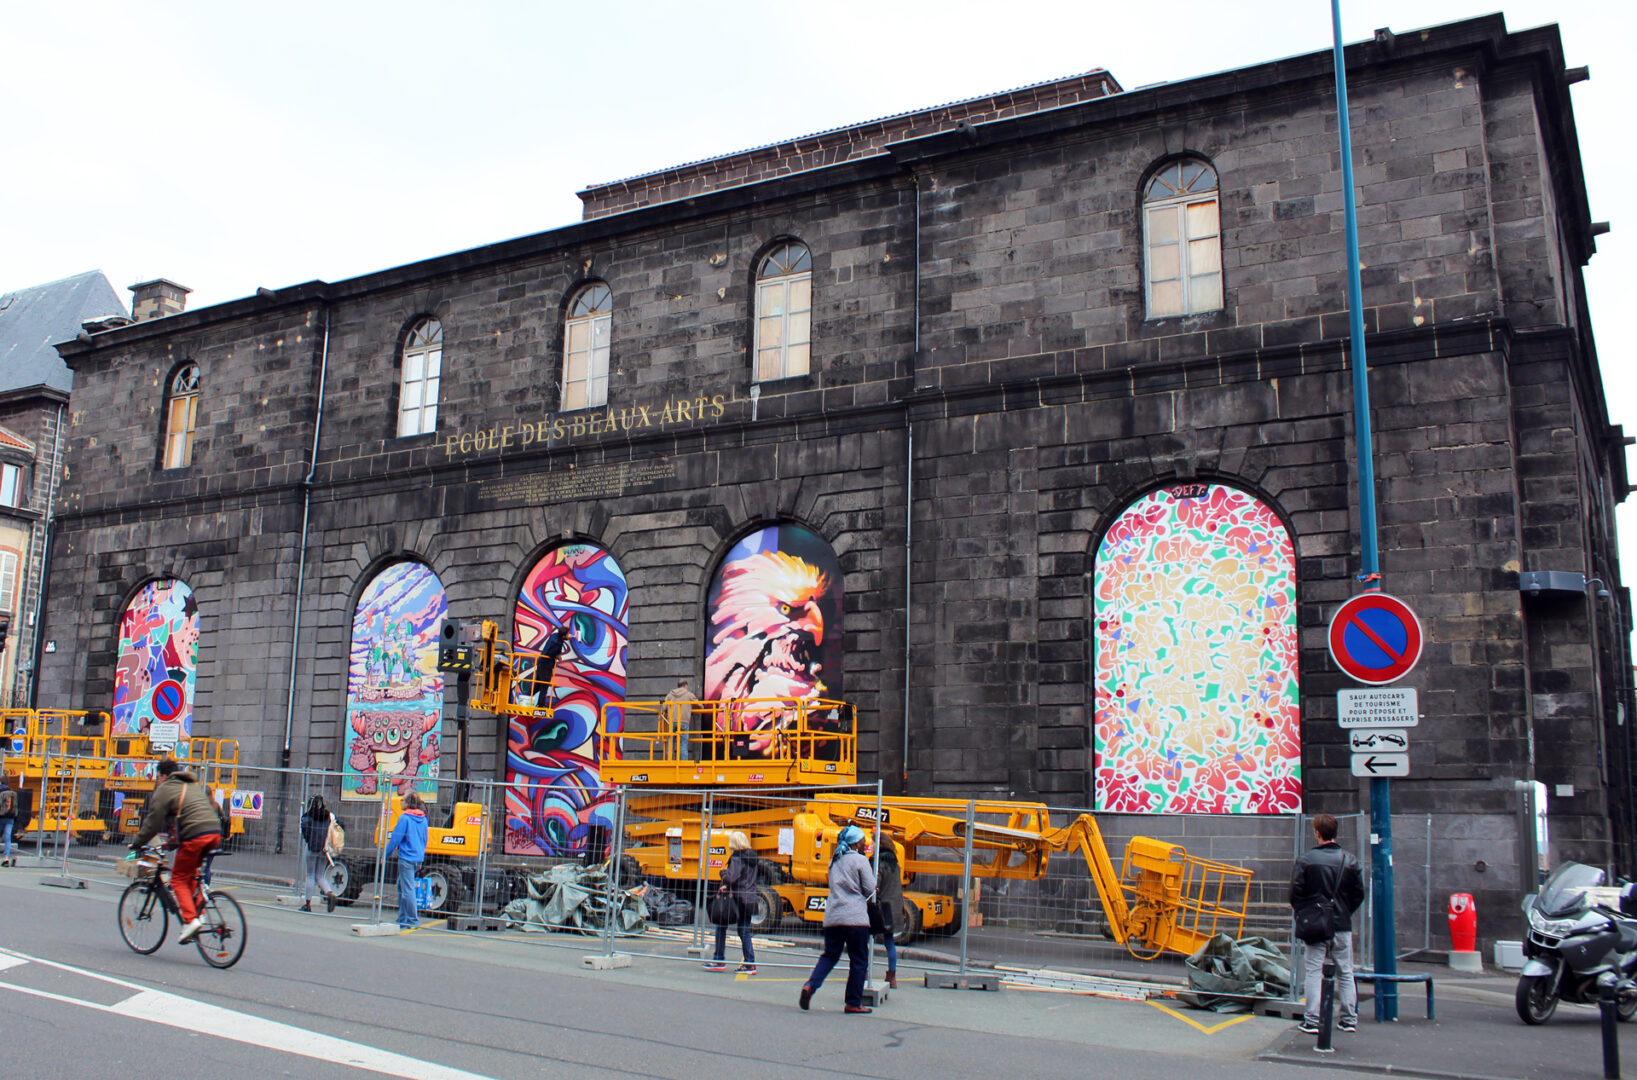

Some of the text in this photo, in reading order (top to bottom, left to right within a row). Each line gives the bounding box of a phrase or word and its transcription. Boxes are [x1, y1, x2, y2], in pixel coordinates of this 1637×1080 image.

[445, 426, 514, 456] ECOLE
[521, 418, 566, 445] DES
[443, 836, 464, 844] SALTI
